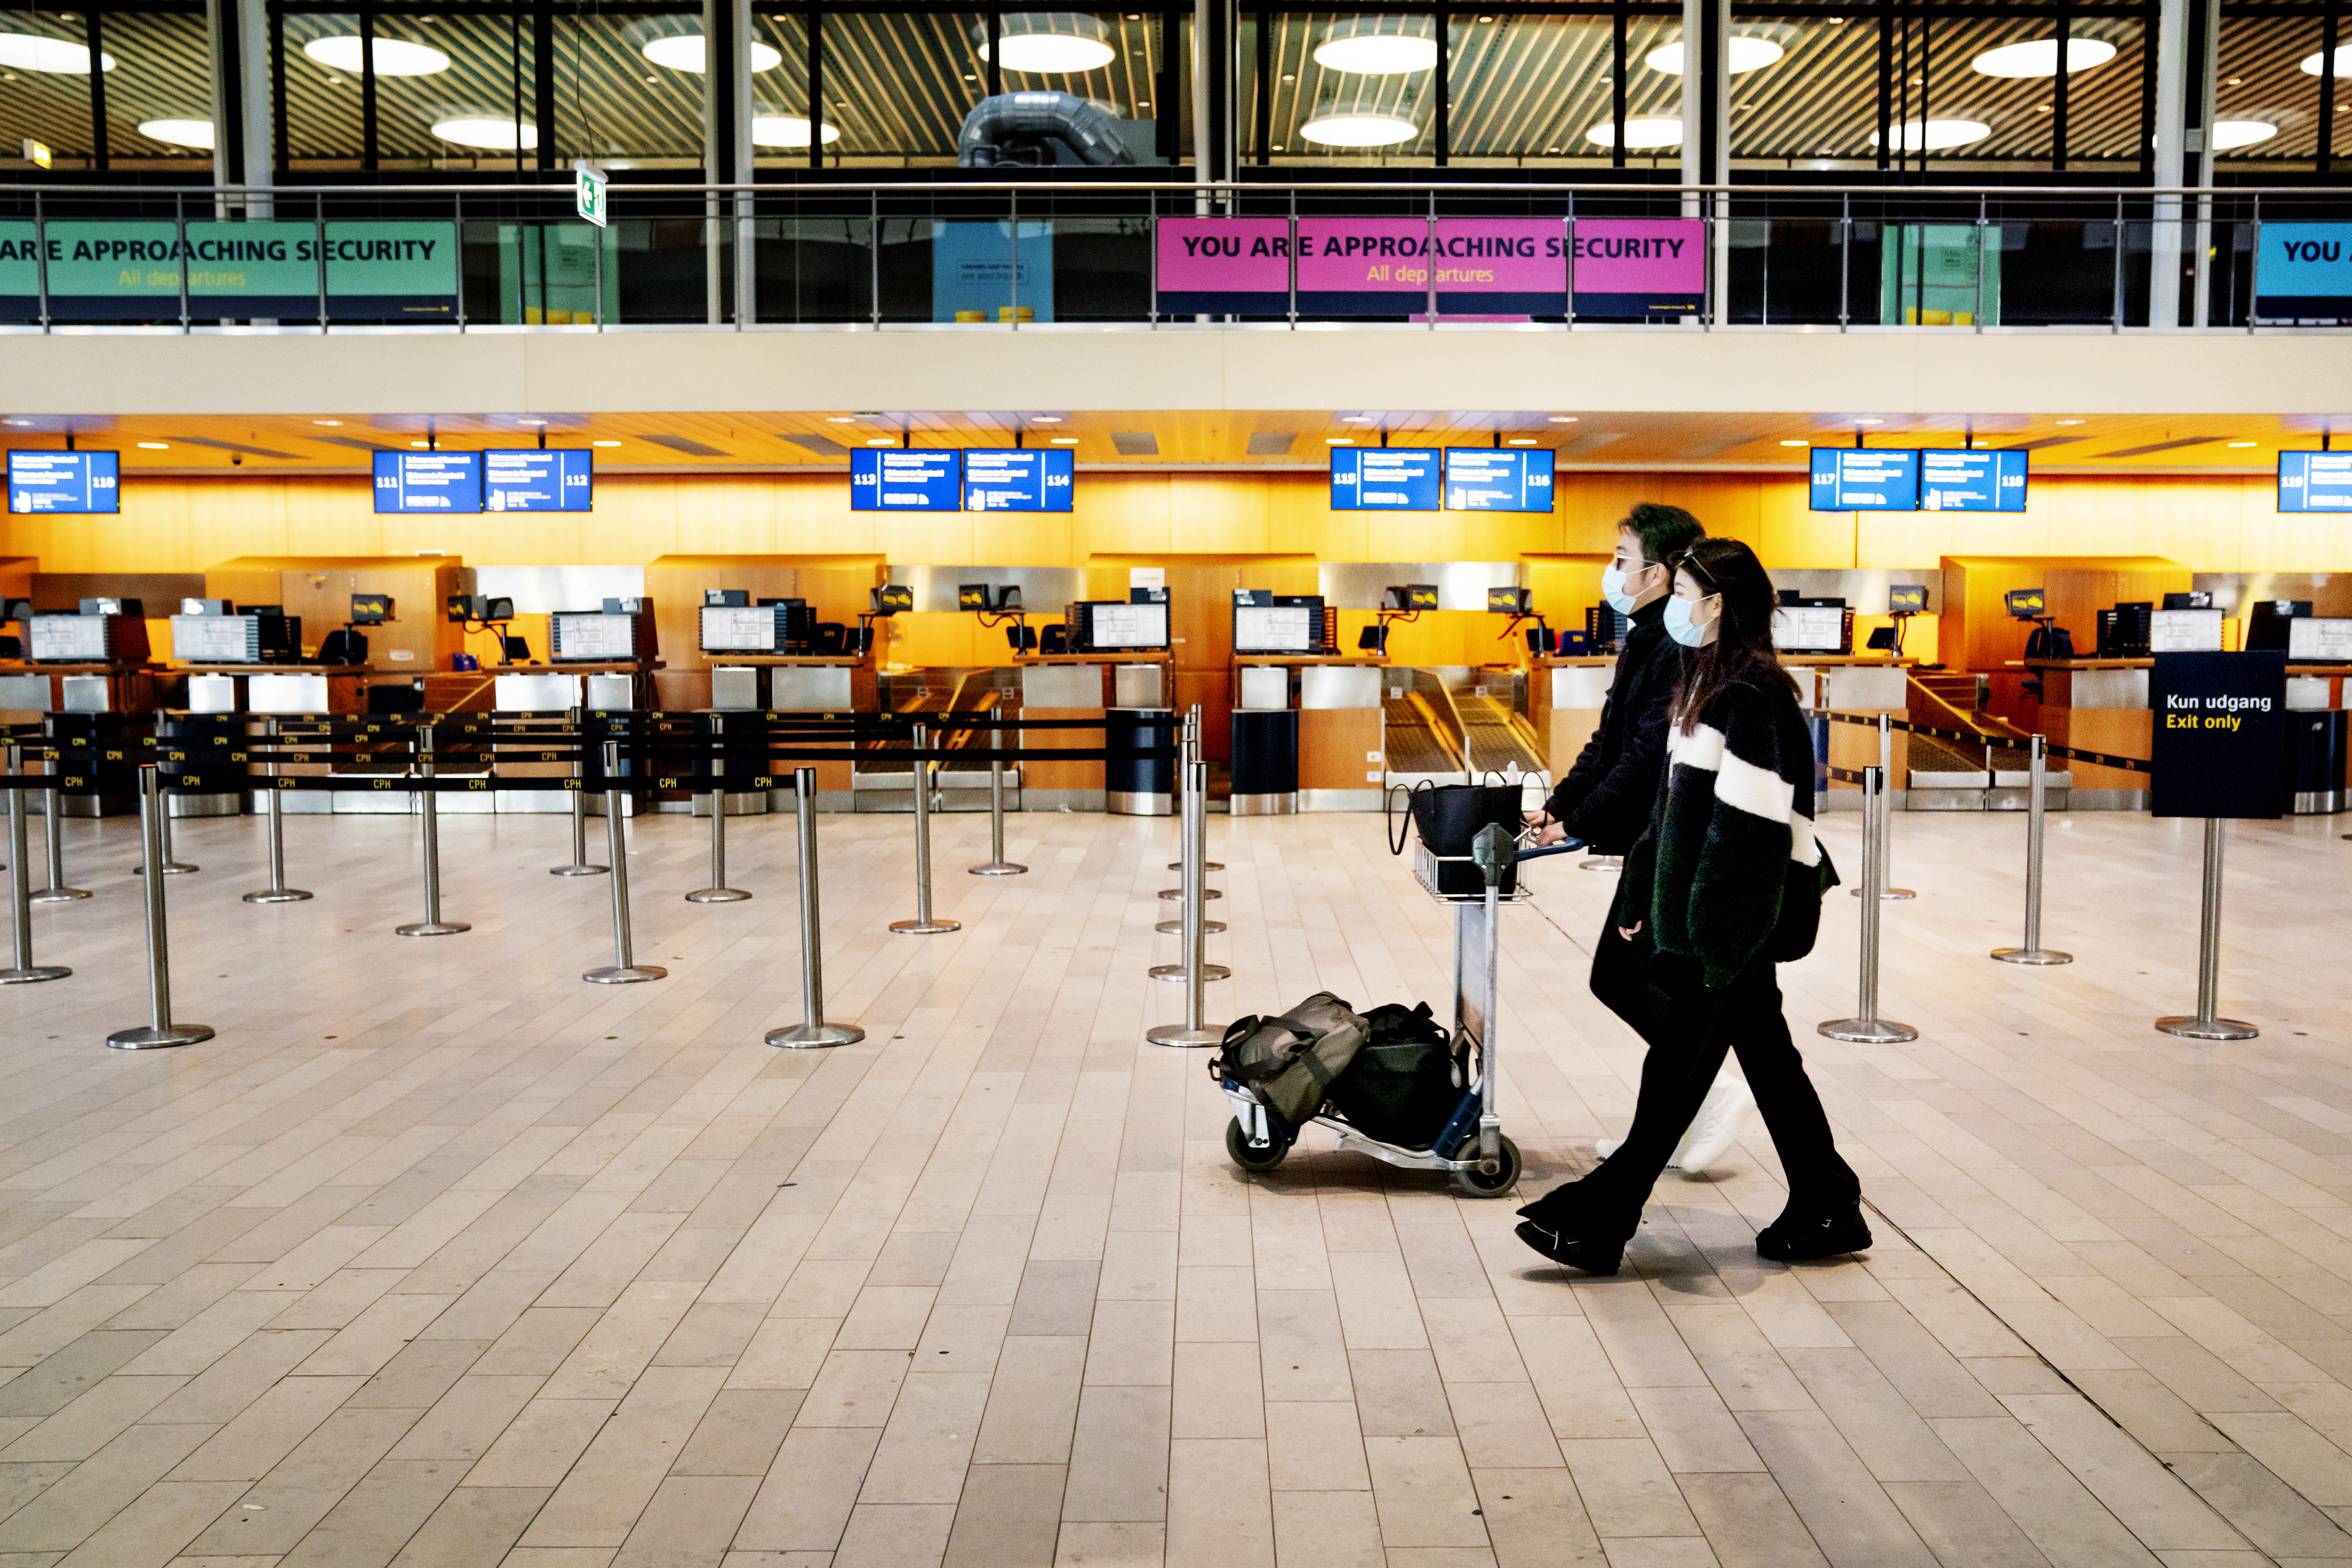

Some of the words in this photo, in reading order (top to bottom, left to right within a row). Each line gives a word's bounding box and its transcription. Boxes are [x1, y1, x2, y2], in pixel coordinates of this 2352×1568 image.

[0, 240, 62, 260] ARE
[73, 240, 286, 261] APPROACHING
[297, 240, 436, 261] SECURITY
[1183, 237, 1240, 257] YOU
[1250, 237, 1313, 257] ARE
[1323, 237, 1534, 257] APPROACHING
[1546, 237, 1684, 258] SECURITY
[2284, 241, 2340, 262] YOU
[119, 269, 141, 285] All
[147, 269, 246, 287] departures
[1367, 265, 1389, 281] All
[1395, 265, 1494, 285] departures
[376, 476, 398, 488] 111
[566, 474, 588, 486] 112
[854, 474, 876, 485] 113
[1047, 475, 1070, 487] 114
[1334, 473, 1357, 484] 115
[1528, 474, 1550, 487] 116
[1813, 473, 1836, 485] 117
[2166, 694, 2199, 709] Kun
[2205, 694, 2272, 712] udgang
[2166, 714, 2198, 729] Exit
[2205, 714, 2242, 732] only
[214, 737, 228, 745] CPH
[355, 734, 368, 743] CPH
[106, 750, 123, 760] CPH
[169, 751, 185, 761] CPH
[231, 752, 247, 762] CPH
[293, 753, 309, 763] CPH
[355, 753, 371, 763] CPH
[418, 754, 433, 763] CPH
[479, 752, 495, 762] CPH
[541, 752, 557, 761] CPH
[65, 776, 83, 787] CPH
[183, 776, 201, 786] CPH
[278, 778, 295, 789] CPH
[373, 779, 391, 789] CPH
[468, 779, 486, 790] CPH
[563, 779, 581, 789] CPH
[659, 778, 677, 789] CPH
[755, 777, 772, 787] CPH
